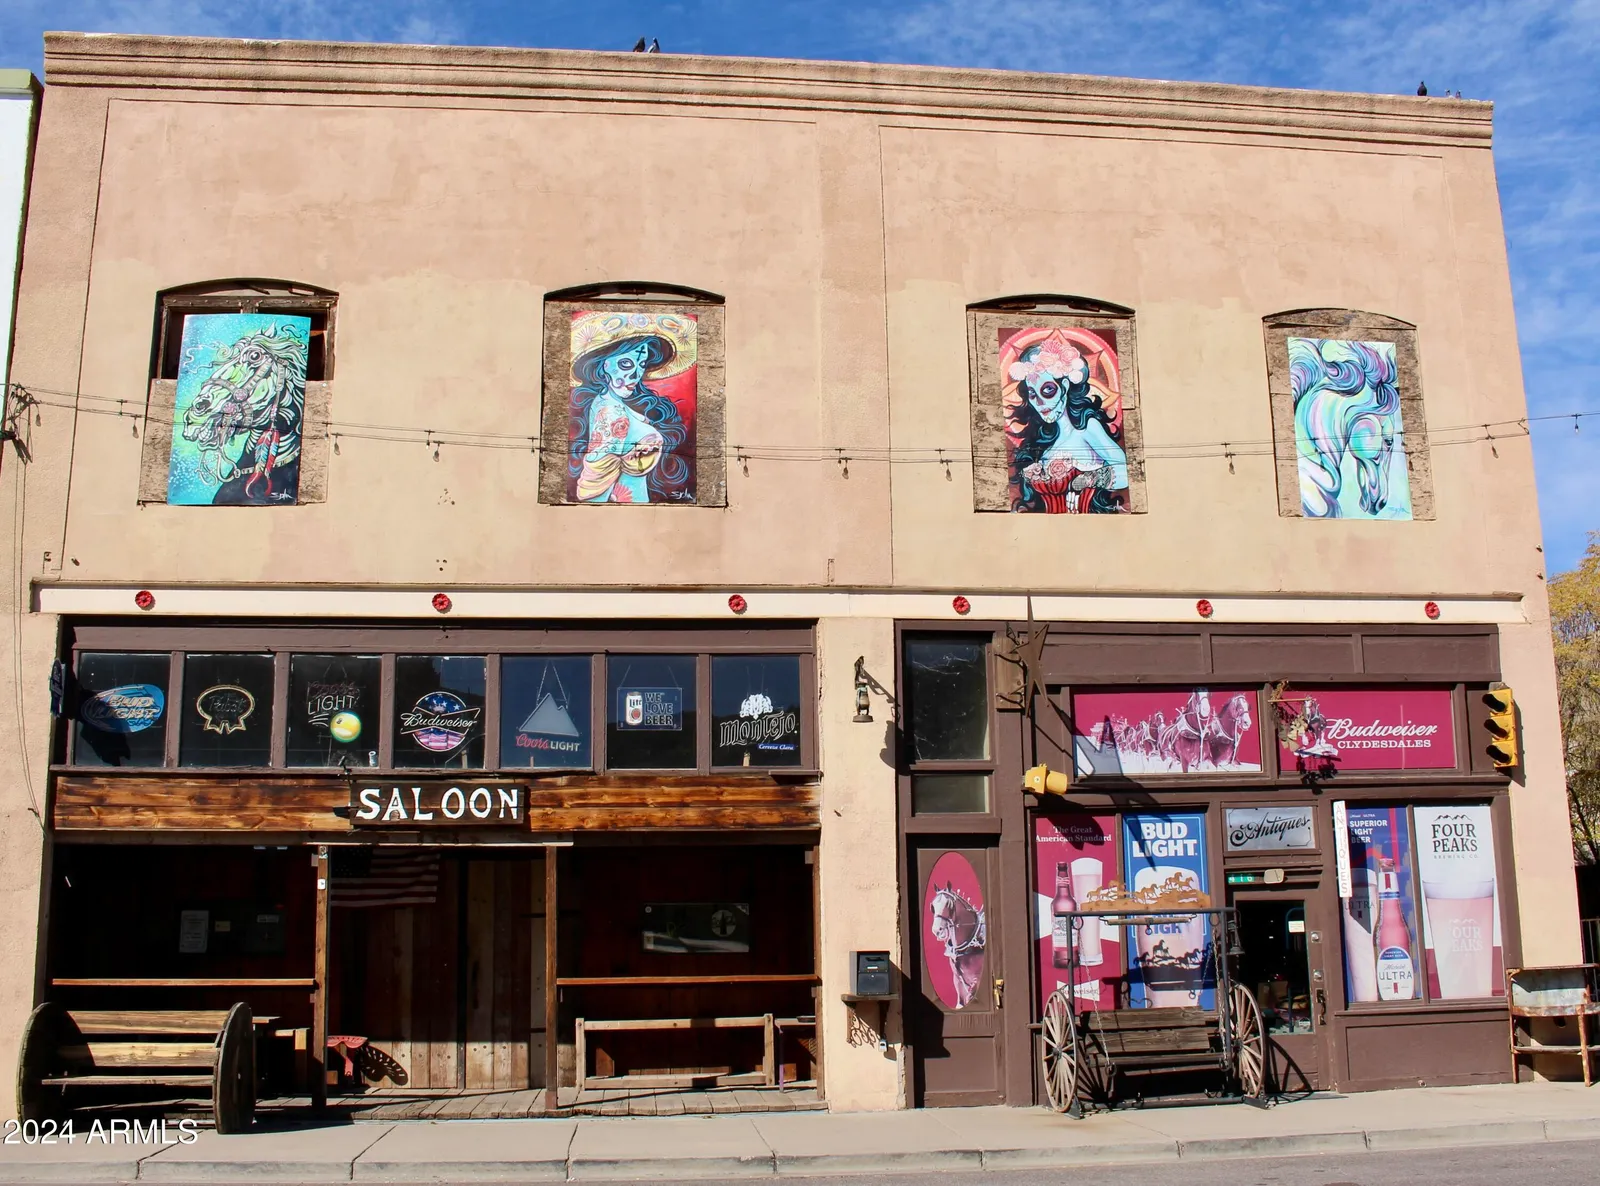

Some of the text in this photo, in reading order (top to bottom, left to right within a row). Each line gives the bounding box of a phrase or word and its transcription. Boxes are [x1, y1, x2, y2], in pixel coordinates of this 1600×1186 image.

[106, 695, 155, 708] BUD
[644, 692, 662, 703] WE
[308, 695, 354, 715] LIGHT
[644, 703, 674, 714] LOVE
[400, 713, 478, 728] Budweiser
[644, 715, 674, 725] BEER
[1325, 718, 1438, 740] Budweiser
[516, 733, 580, 752] Coors LIGHT
[1337, 739, 1432, 749] CLYDESDALES
[355, 787, 518, 821] SALOON
[1053, 825, 1093, 834] The Great
[1229, 811, 1311, 847] Antiques
[1349, 819, 1388, 828] SUPERIOR
[1140, 822, 1188, 840] BUD
[1350, 828, 1374, 836] LIGHT
[1431, 823, 1477, 839] FOUR
[1036, 834, 1112, 843] American Standard
[1351, 836, 1372, 844] BEER
[1433, 838, 1478, 852] PEAKS
[1132, 839, 1198, 858] LIGHT
[1451, 925, 1482, 939] OUR
[1452, 938, 1484, 952] EAKS
[1379, 971, 1412, 980] ULTRA
